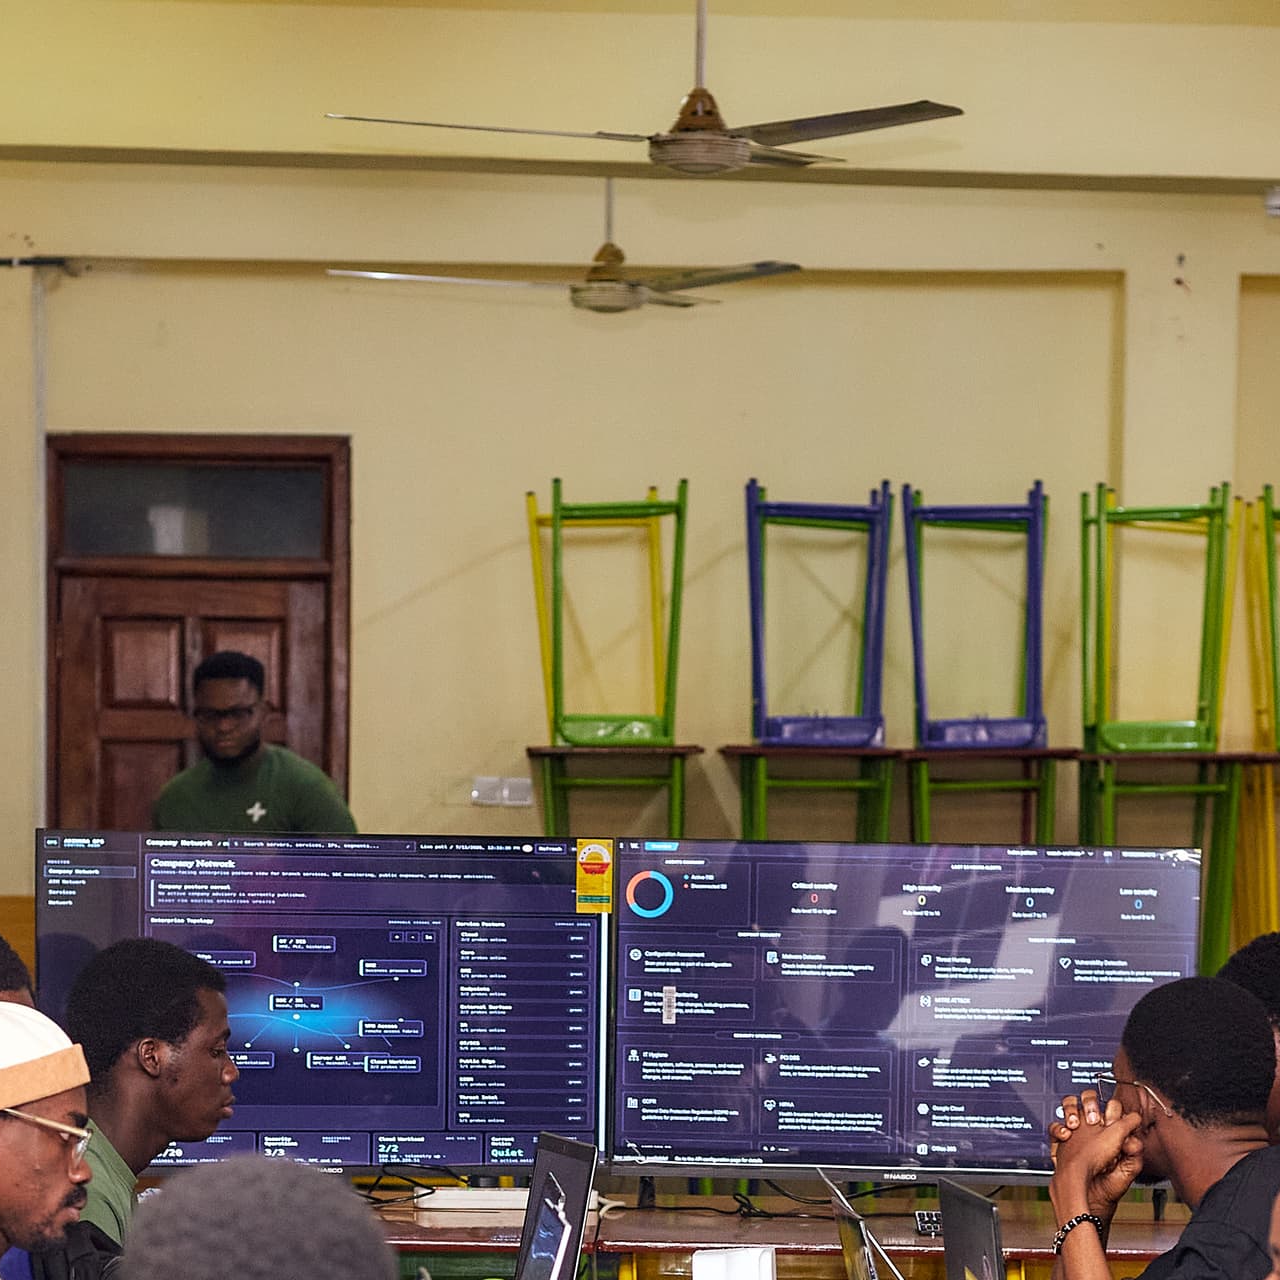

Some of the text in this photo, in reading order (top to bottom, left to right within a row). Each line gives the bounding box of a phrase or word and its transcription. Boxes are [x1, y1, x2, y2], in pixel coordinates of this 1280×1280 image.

[146, 839, 177, 847] Company
[151, 859, 235, 868] Company Network
[811, 894, 818, 903] 0
[918, 895, 926, 905] 0
[1026, 897, 1034, 907] 0
[1135, 899, 1142, 909] 0
[379, 1144, 398, 1152] 2/2
[491, 1149, 523, 1157] Quiet
